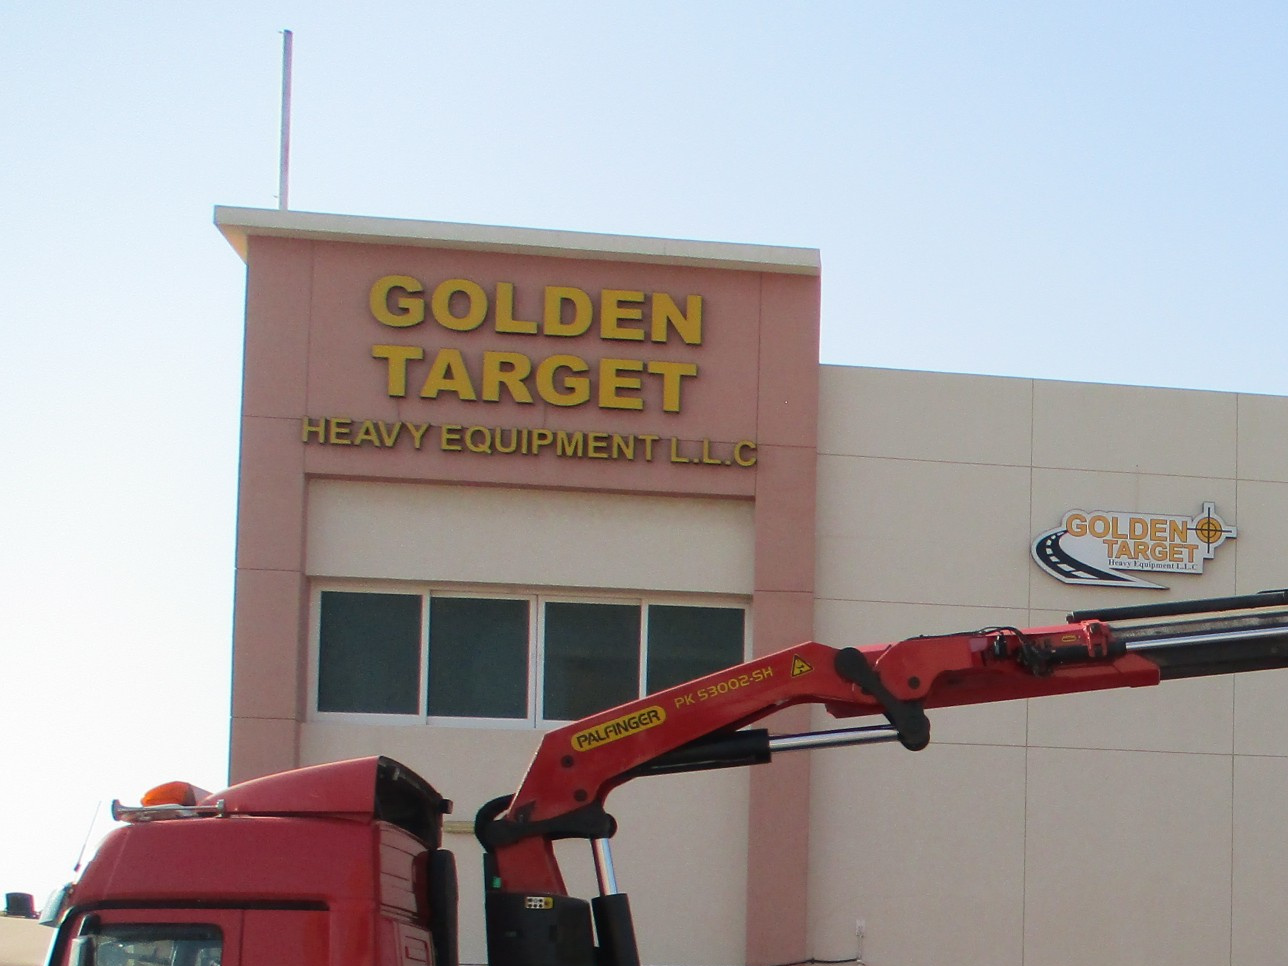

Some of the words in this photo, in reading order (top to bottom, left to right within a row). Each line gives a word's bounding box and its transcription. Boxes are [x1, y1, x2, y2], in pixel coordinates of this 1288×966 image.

[369, 274, 702, 345] GOLDEN
[371, 344, 698, 413] TARGET
[301, 415, 430, 450] HEAVY
[440, 424, 659, 461] EQUIPMENT
[670, 437, 757, 468] L.L.C
[1066, 513, 1188, 543] GOLDEN
[1103, 539, 1199, 563] TARGET
[1108, 559, 1132, 569] Heavy
[1134, 560, 1174, 570] Equipment
[674, 693, 696, 710] PK
[697, 666, 774, 702] 53002-SH
[576, 709, 662, 749] PALFINGER
